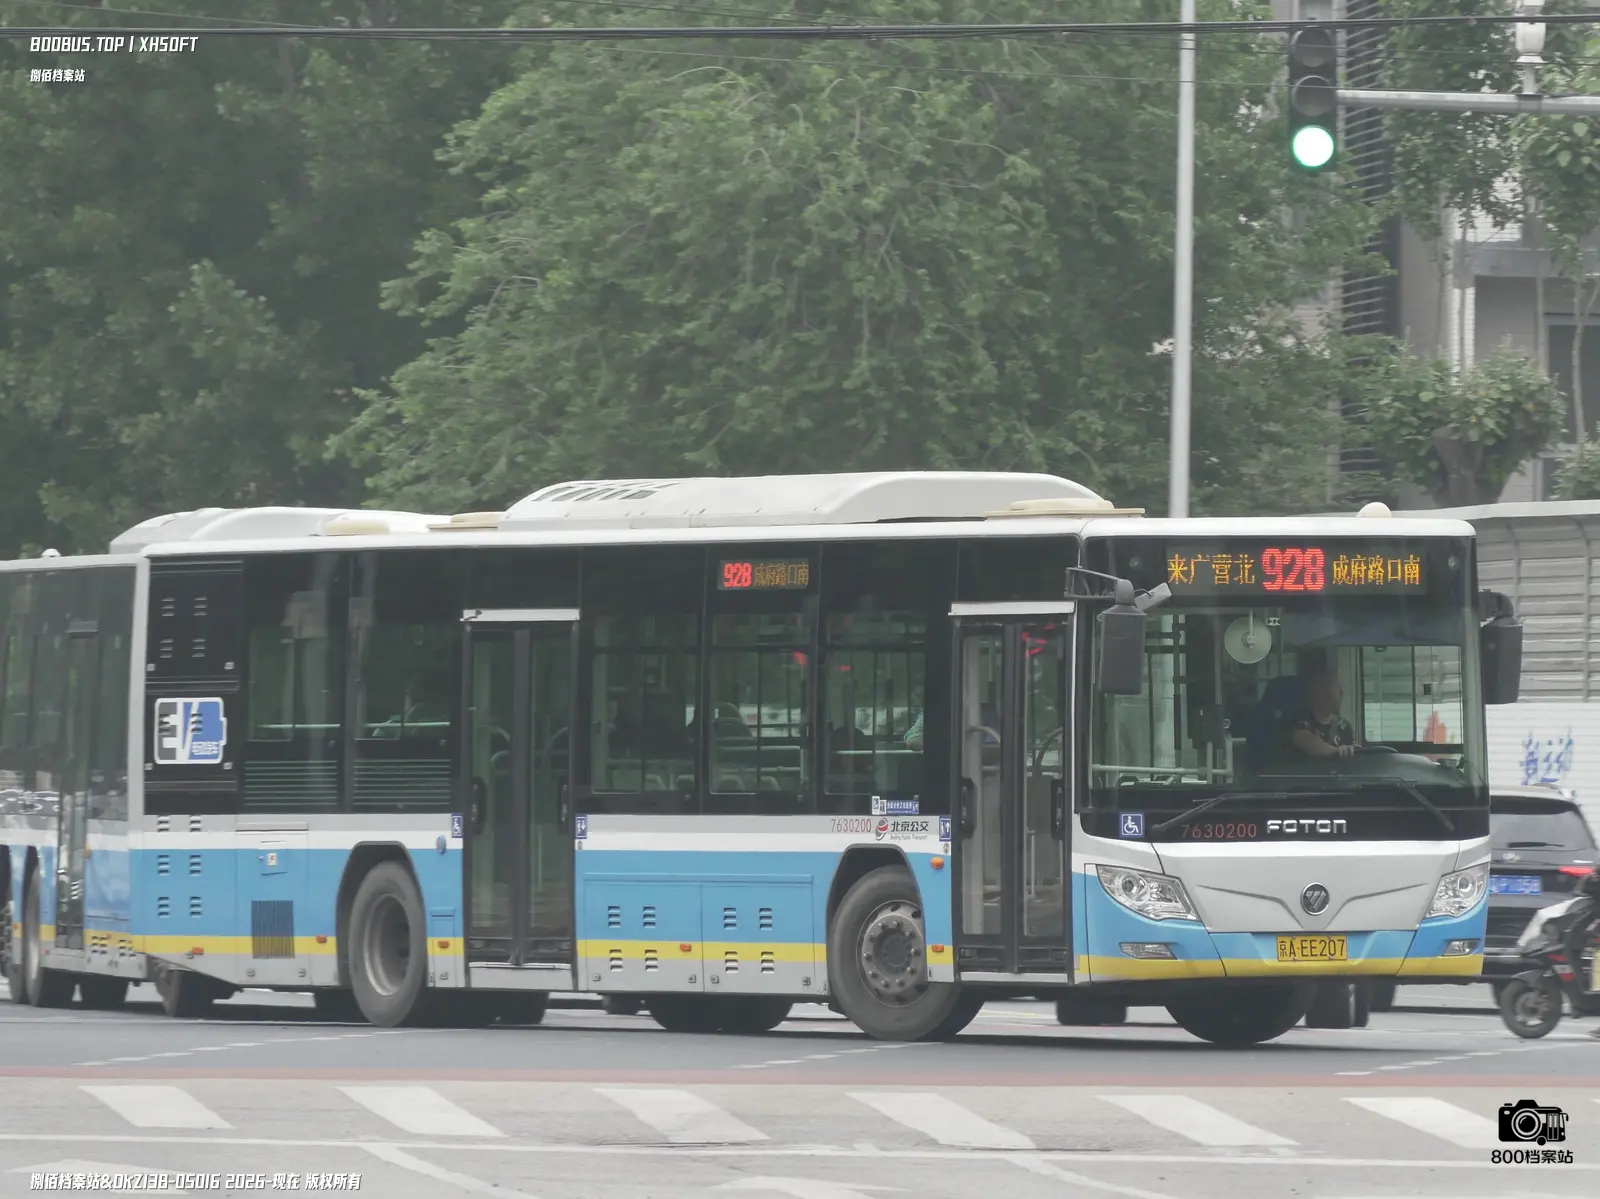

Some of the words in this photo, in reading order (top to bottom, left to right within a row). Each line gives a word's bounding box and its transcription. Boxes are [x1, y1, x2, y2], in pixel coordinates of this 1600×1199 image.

[723, 562, 752, 587] 928
[1167, 554, 1256, 585] 来广营北
[1261, 548, 1326, 591] 928
[1332, 554, 1420, 585] 成府路口南
[831, 818, 872, 833] 7630200
[890, 820, 930, 832] 北京公交
[1181, 823, 1258, 839] 7630200
[1266, 819, 1348, 834] FOTON
